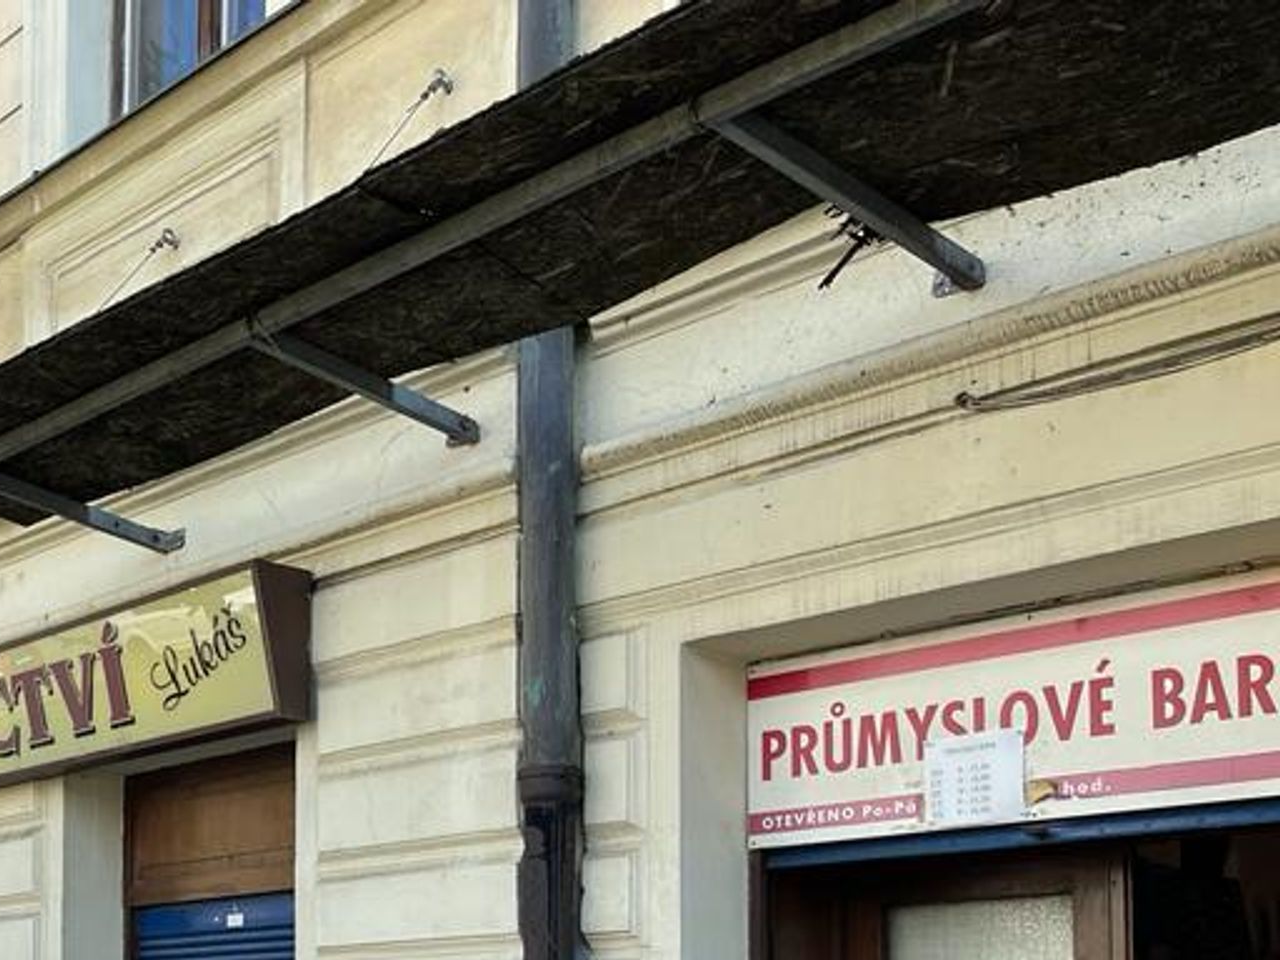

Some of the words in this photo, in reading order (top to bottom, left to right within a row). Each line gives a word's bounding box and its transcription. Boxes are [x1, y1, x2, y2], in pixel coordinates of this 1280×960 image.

[150, 602, 248, 712] Lukáš
[1152, 653, 1277, 729] BAR
[762, 806, 855, 830] OTEVŘENO
